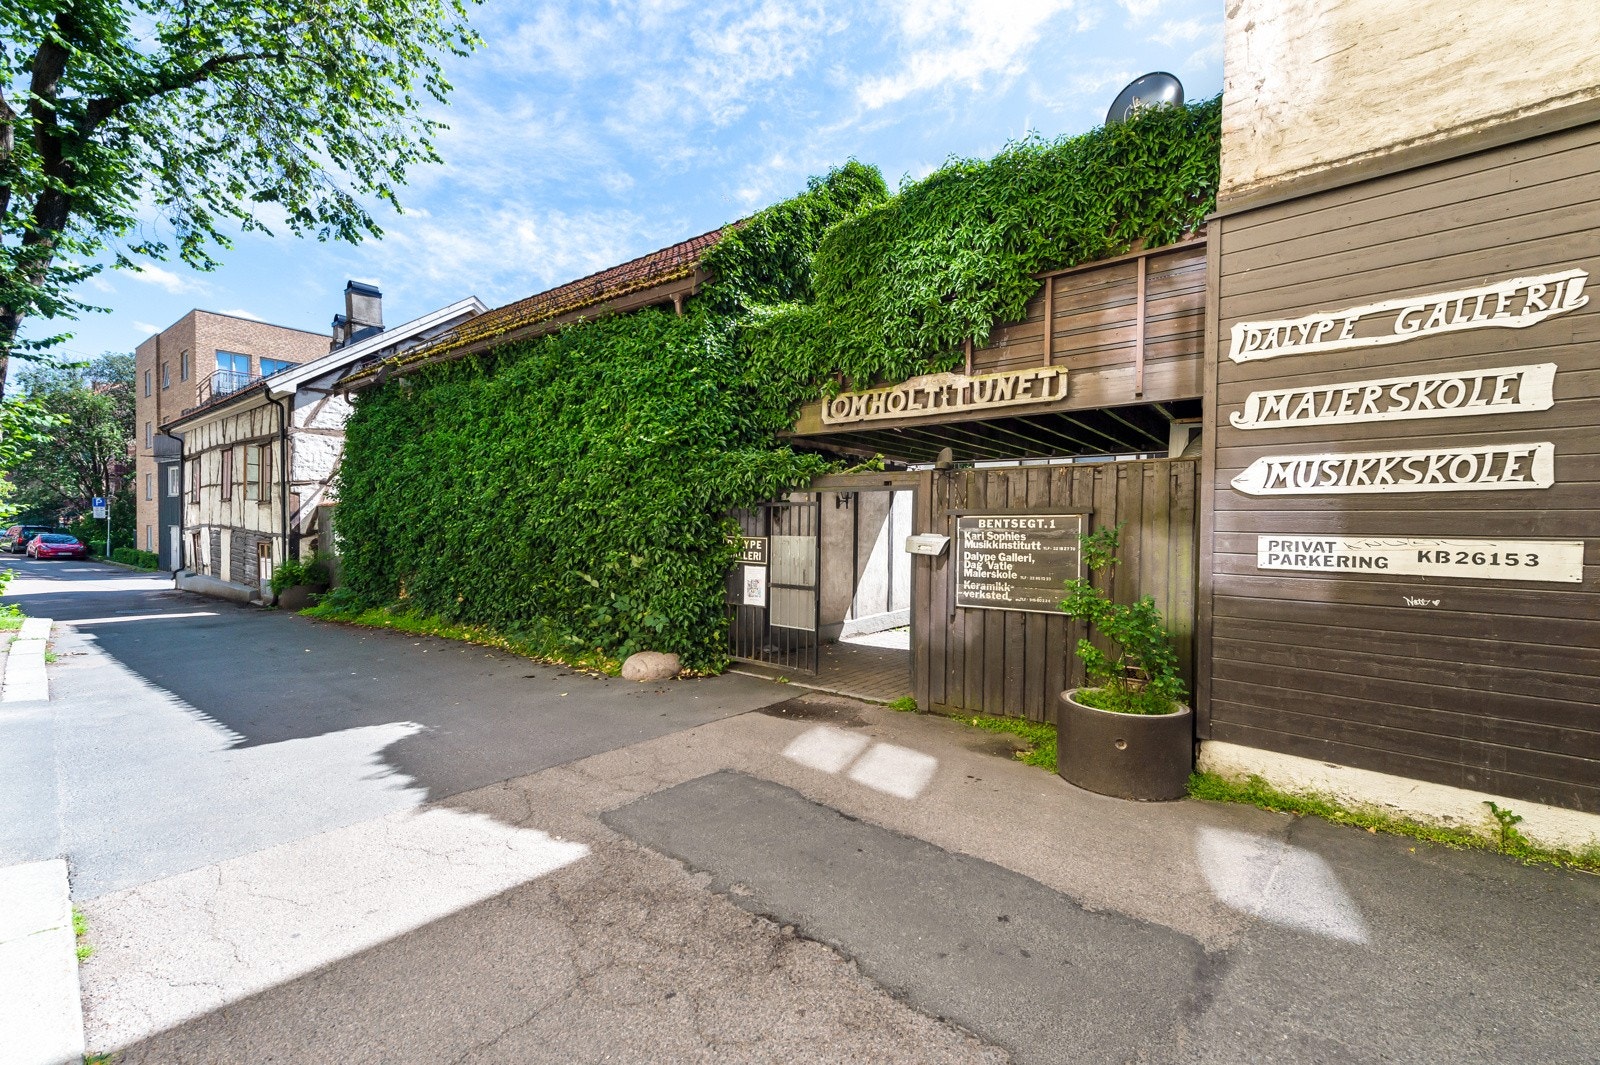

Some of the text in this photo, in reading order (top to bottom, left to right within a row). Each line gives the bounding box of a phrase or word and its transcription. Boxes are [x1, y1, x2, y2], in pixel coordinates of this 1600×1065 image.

[1243, 282, 1568, 352] DALYPE GALLERI
[1258, 373, 1519, 422] MALERSKOLE
[1264, 450, 1530, 488] MUSIKKSKOLE
[964, 531, 1026, 541] Kari Sophies
[964, 540, 1041, 550] Musikkinstitutt
[1268, 540, 1336, 553] PRIVAT
[963, 552, 996, 563] Dalype
[1268, 554, 1388, 569] PARKERING
[1417, 550, 1540, 567] KB26153
[963, 561, 983, 571] Dag
[963, 569, 1017, 579] Malerskole
